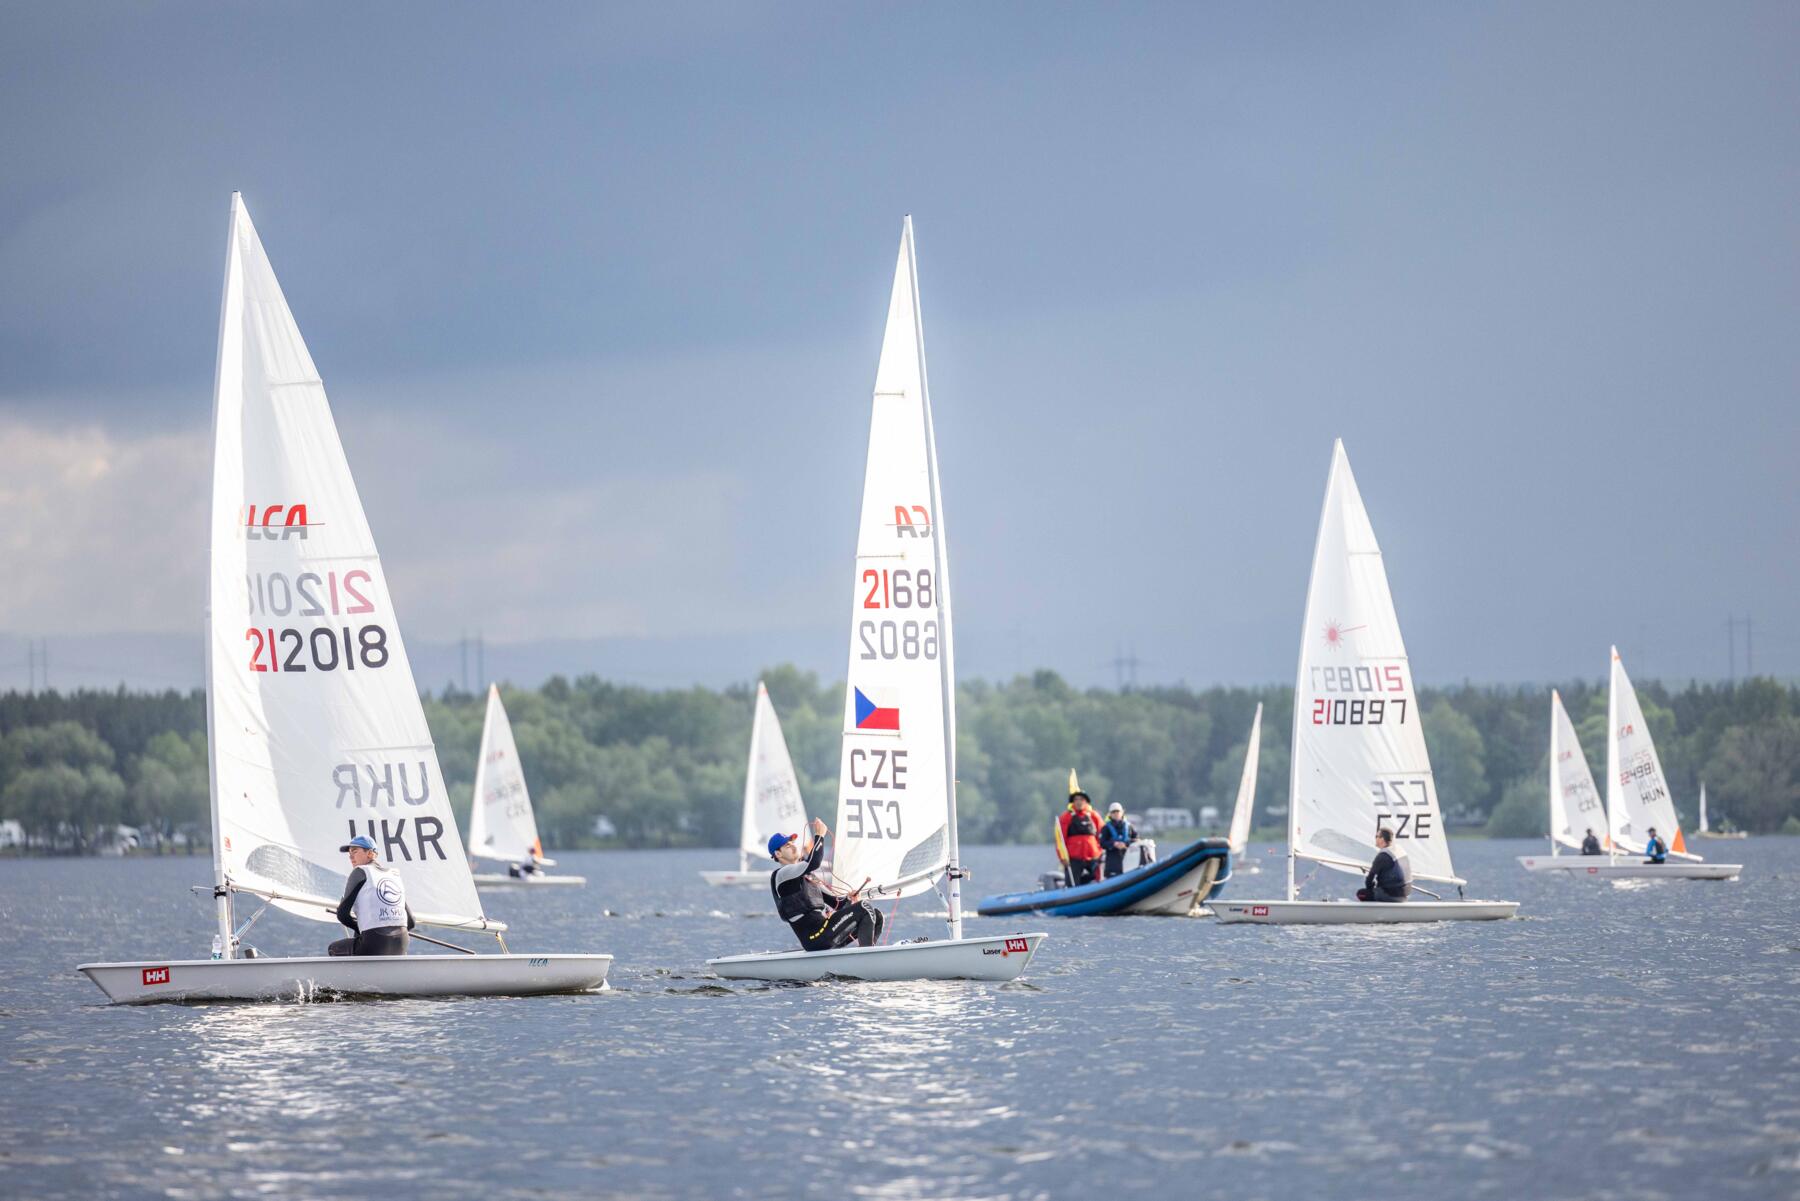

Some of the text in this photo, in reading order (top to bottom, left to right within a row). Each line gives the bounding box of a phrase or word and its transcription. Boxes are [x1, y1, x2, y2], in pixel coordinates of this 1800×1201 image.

[862, 569, 938, 609] 2168
[245, 624, 389, 672] 212018
[1313, 699, 1407, 725] 210897
[850, 749, 908, 790] CZE
[1641, 786, 1665, 805] HUN
[1007, 939, 1025, 951] HH
[145, 969, 167, 984] HH
